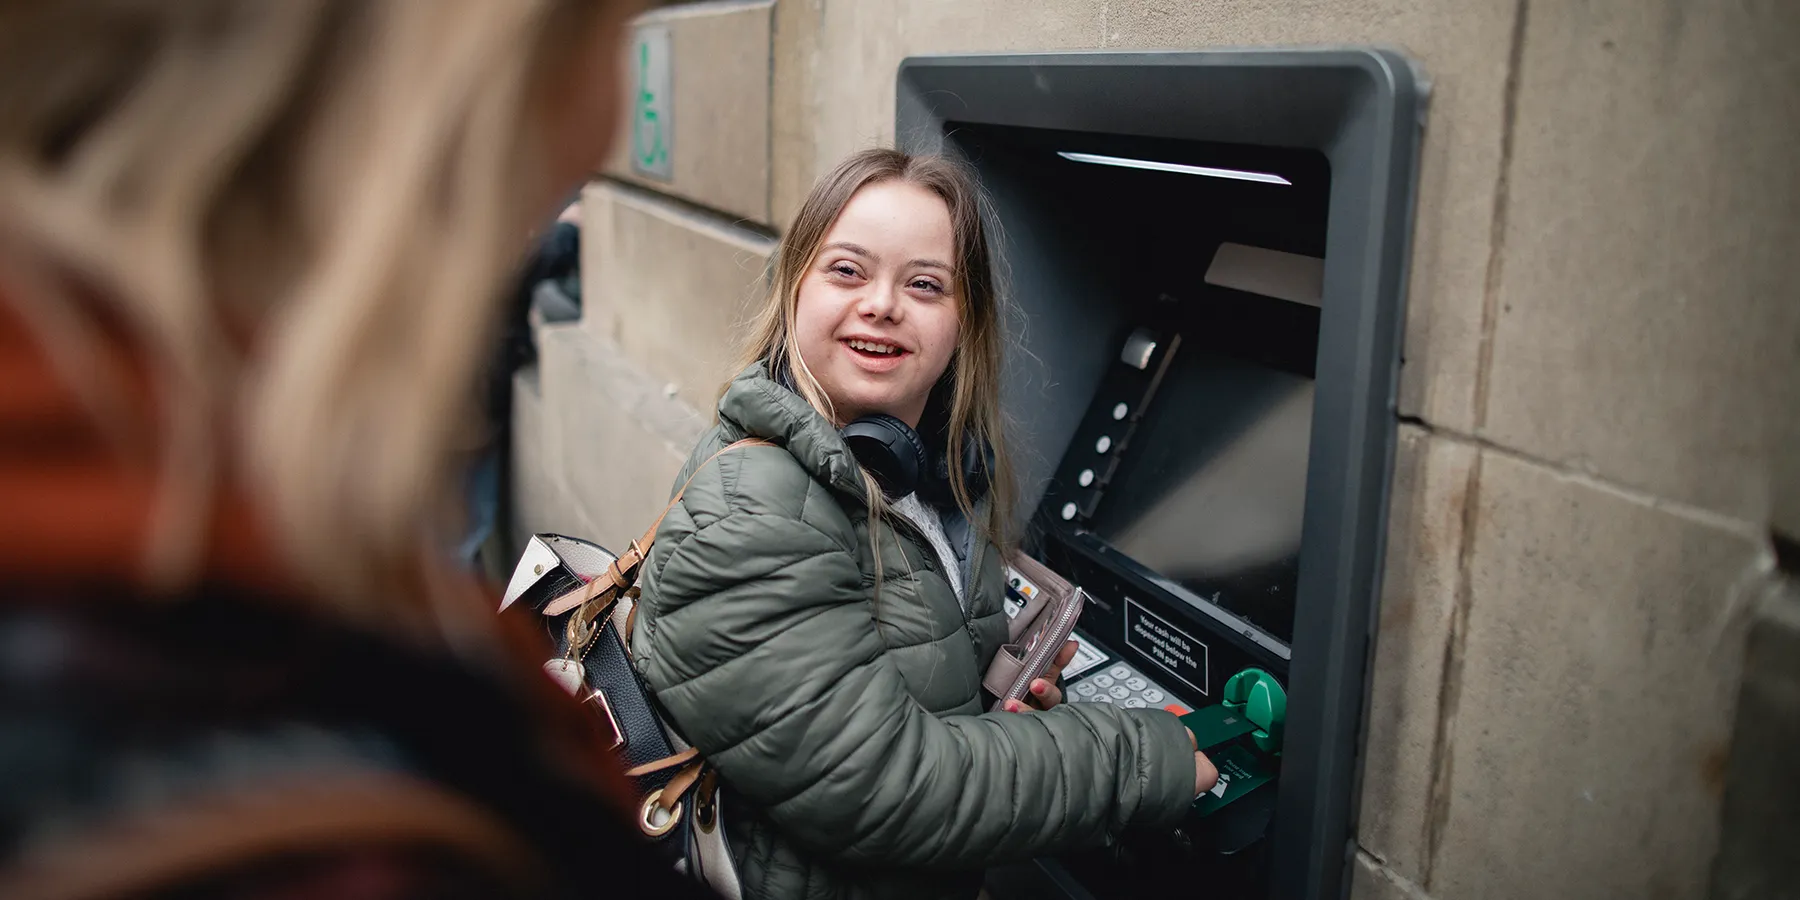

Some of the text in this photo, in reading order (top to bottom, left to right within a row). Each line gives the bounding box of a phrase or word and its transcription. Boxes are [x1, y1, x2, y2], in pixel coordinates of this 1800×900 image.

[1134, 624, 1197, 668] dispensed below the
[1140, 614, 1190, 652] Your cash will be
[1152, 645, 1164, 659] PIN
